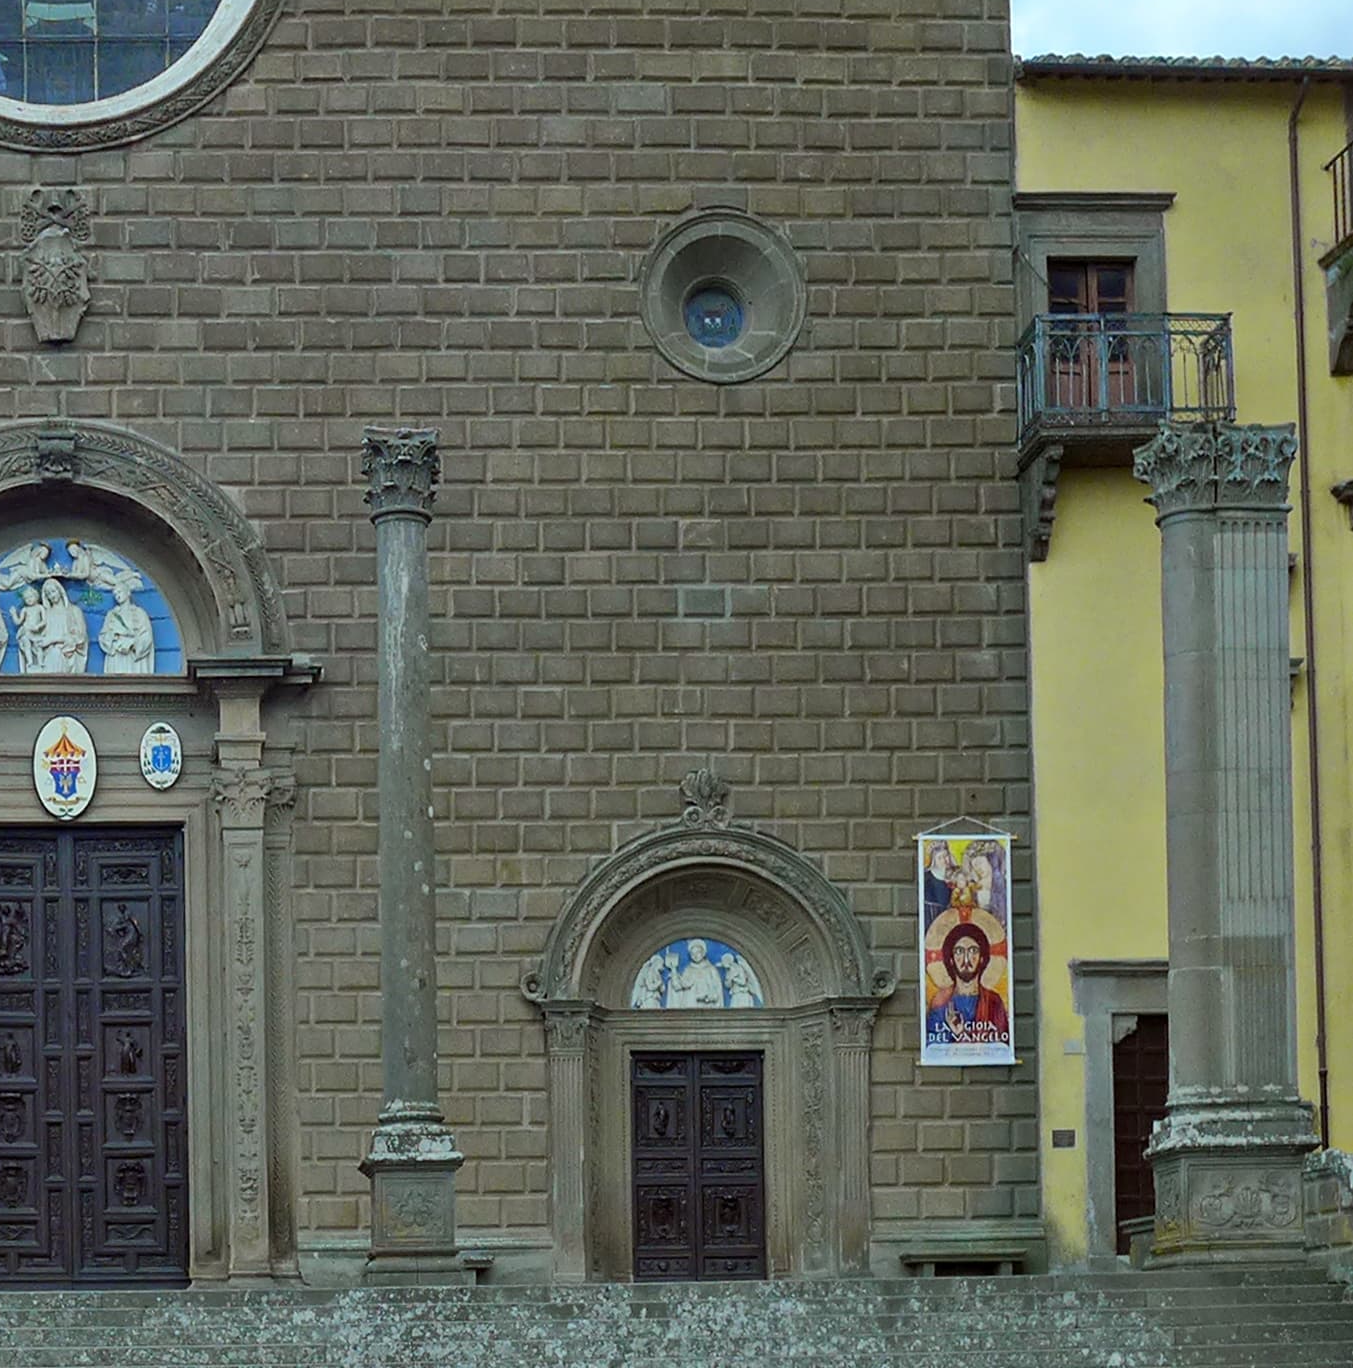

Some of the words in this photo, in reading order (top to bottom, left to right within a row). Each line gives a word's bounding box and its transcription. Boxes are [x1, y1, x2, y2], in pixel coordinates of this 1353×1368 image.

[935, 1021, 951, 1032] LA
[964, 1021, 997, 1032] GIOIA
[929, 1032, 949, 1042] DEL
[951, 1032, 1009, 1042] VANGELO
